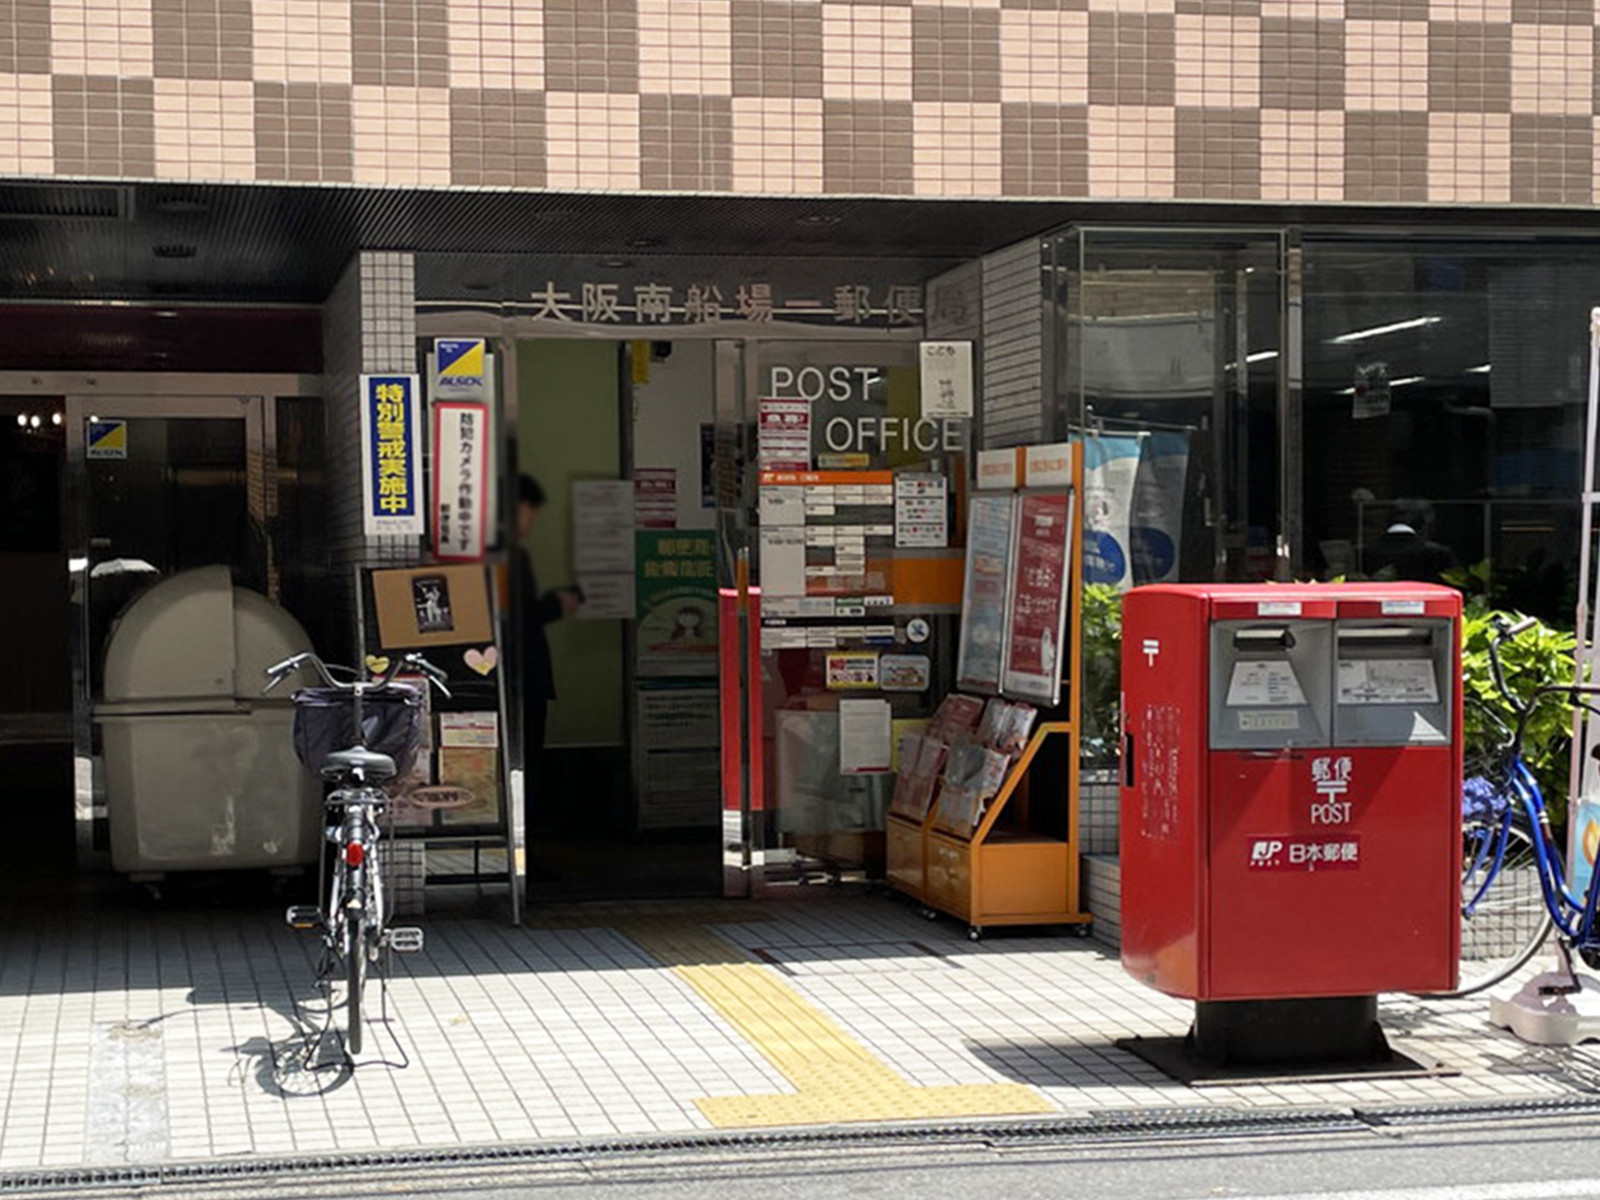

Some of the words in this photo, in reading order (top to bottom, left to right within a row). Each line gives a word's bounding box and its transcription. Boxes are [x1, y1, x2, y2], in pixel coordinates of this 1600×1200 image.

[771, 367, 879, 400] POST
[375, 383, 408, 514] 特別警戒実施中
[826, 417, 963, 451] OFFICE
[1311, 756, 1352, 782] 郵便
[1311, 802, 1352, 825] POST
[1289, 842, 1358, 863] 日本郵便
